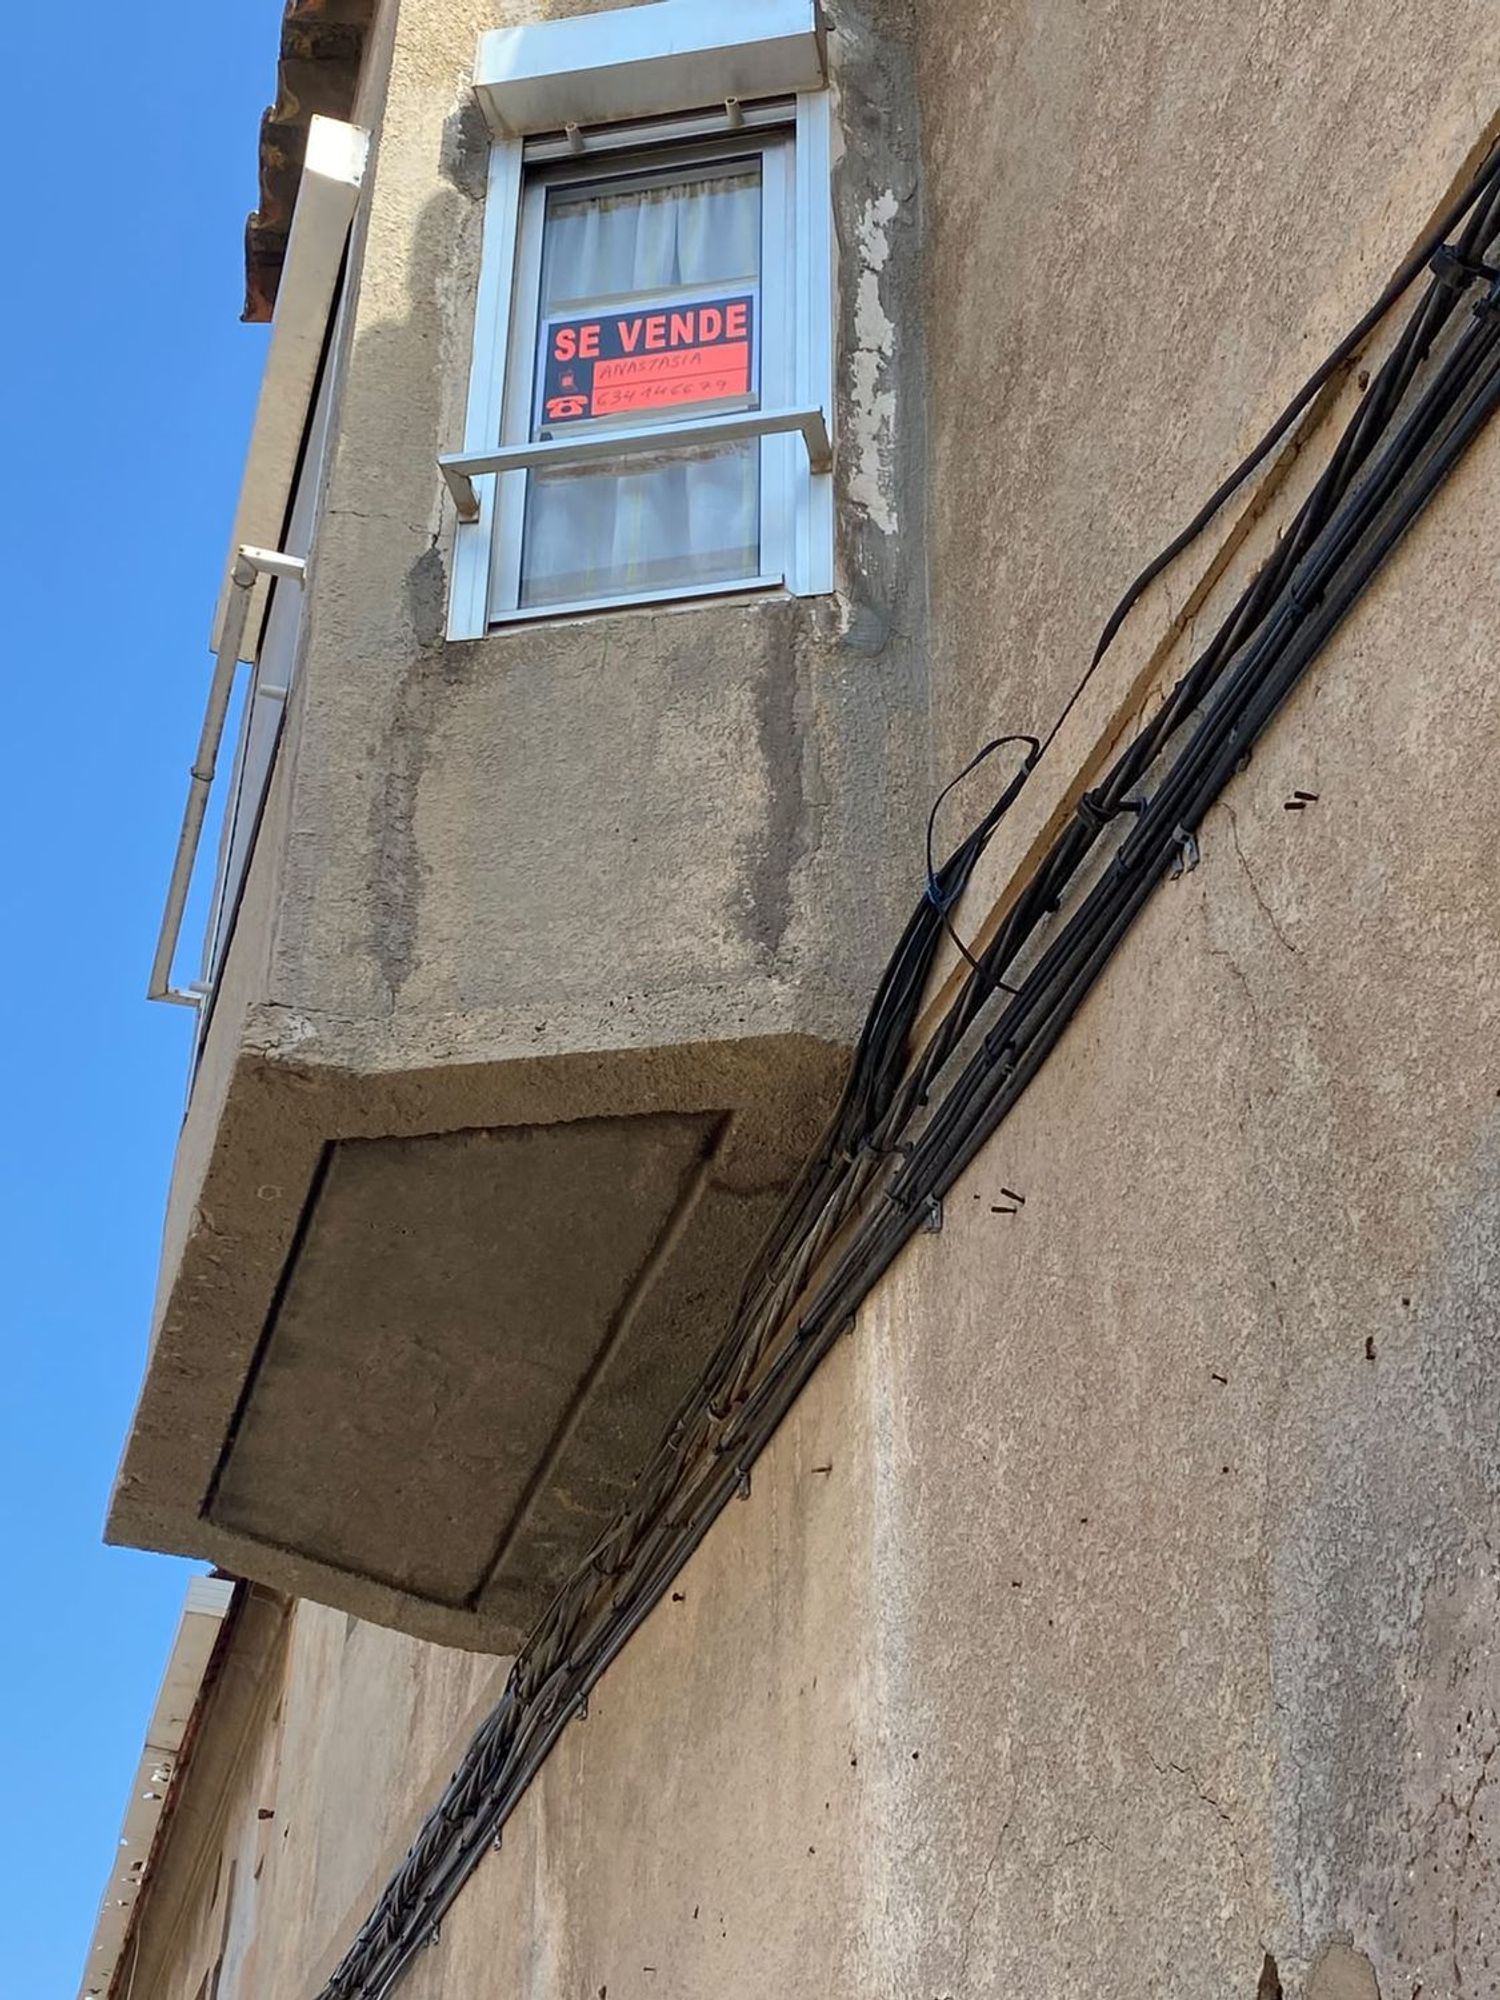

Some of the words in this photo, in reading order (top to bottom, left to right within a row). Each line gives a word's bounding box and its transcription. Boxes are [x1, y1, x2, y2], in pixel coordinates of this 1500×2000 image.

[554, 325, 601, 362] SE
[617, 303, 748, 353] VENDE
[599, 352, 702, 379] ANASTASIA
